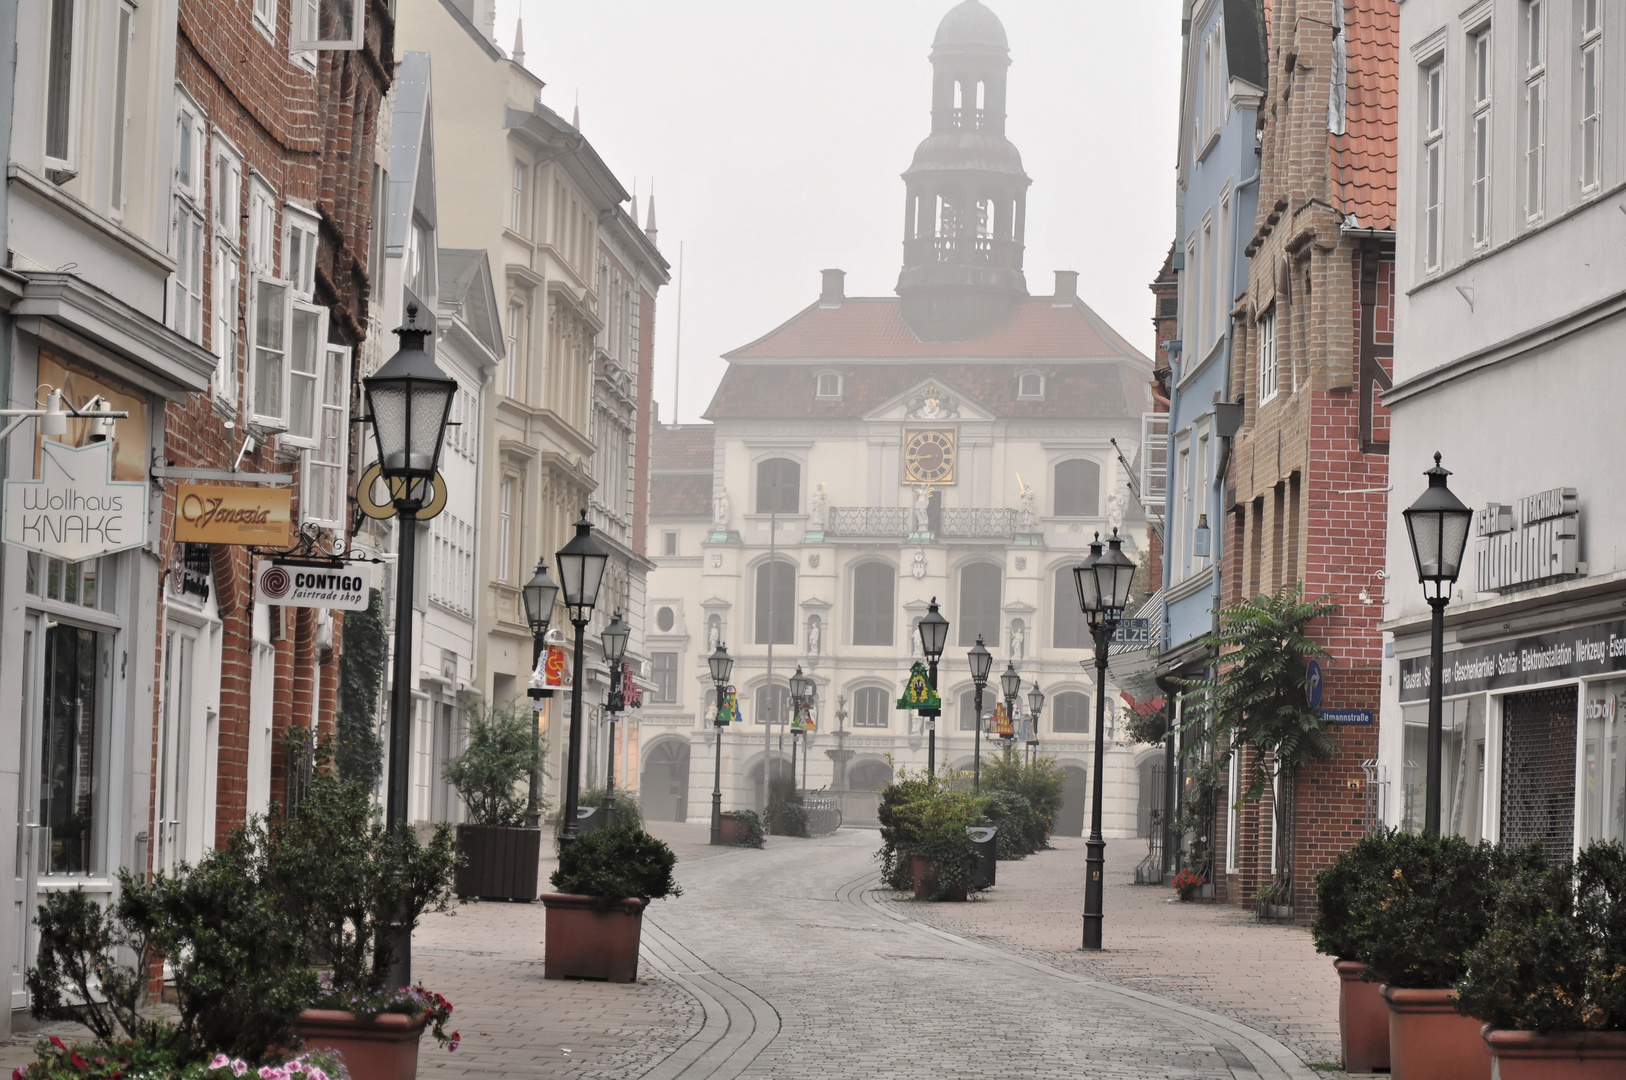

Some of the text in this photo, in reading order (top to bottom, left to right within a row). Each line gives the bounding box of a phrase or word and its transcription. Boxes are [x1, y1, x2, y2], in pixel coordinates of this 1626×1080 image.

[23, 488, 123, 511] Wollhaus
[181, 493, 271, 529] Venezia
[1528, 487, 1565, 522] FACHHAUS
[22, 514, 122, 544] KNAKE
[295, 573, 363, 592] CONTIGO
[291, 588, 362, 604] fairtrade shop
[1116, 619, 1147, 628] ODE &
[1402, 668, 1422, 690] Hausrat
[1454, 654, 1495, 682] Geschenkartikel
[1498, 651, 1518, 676] Sanitär
[1521, 642, 1572, 672] Elektroinstallation
[1575, 637, 1605, 664] Werkzeug
